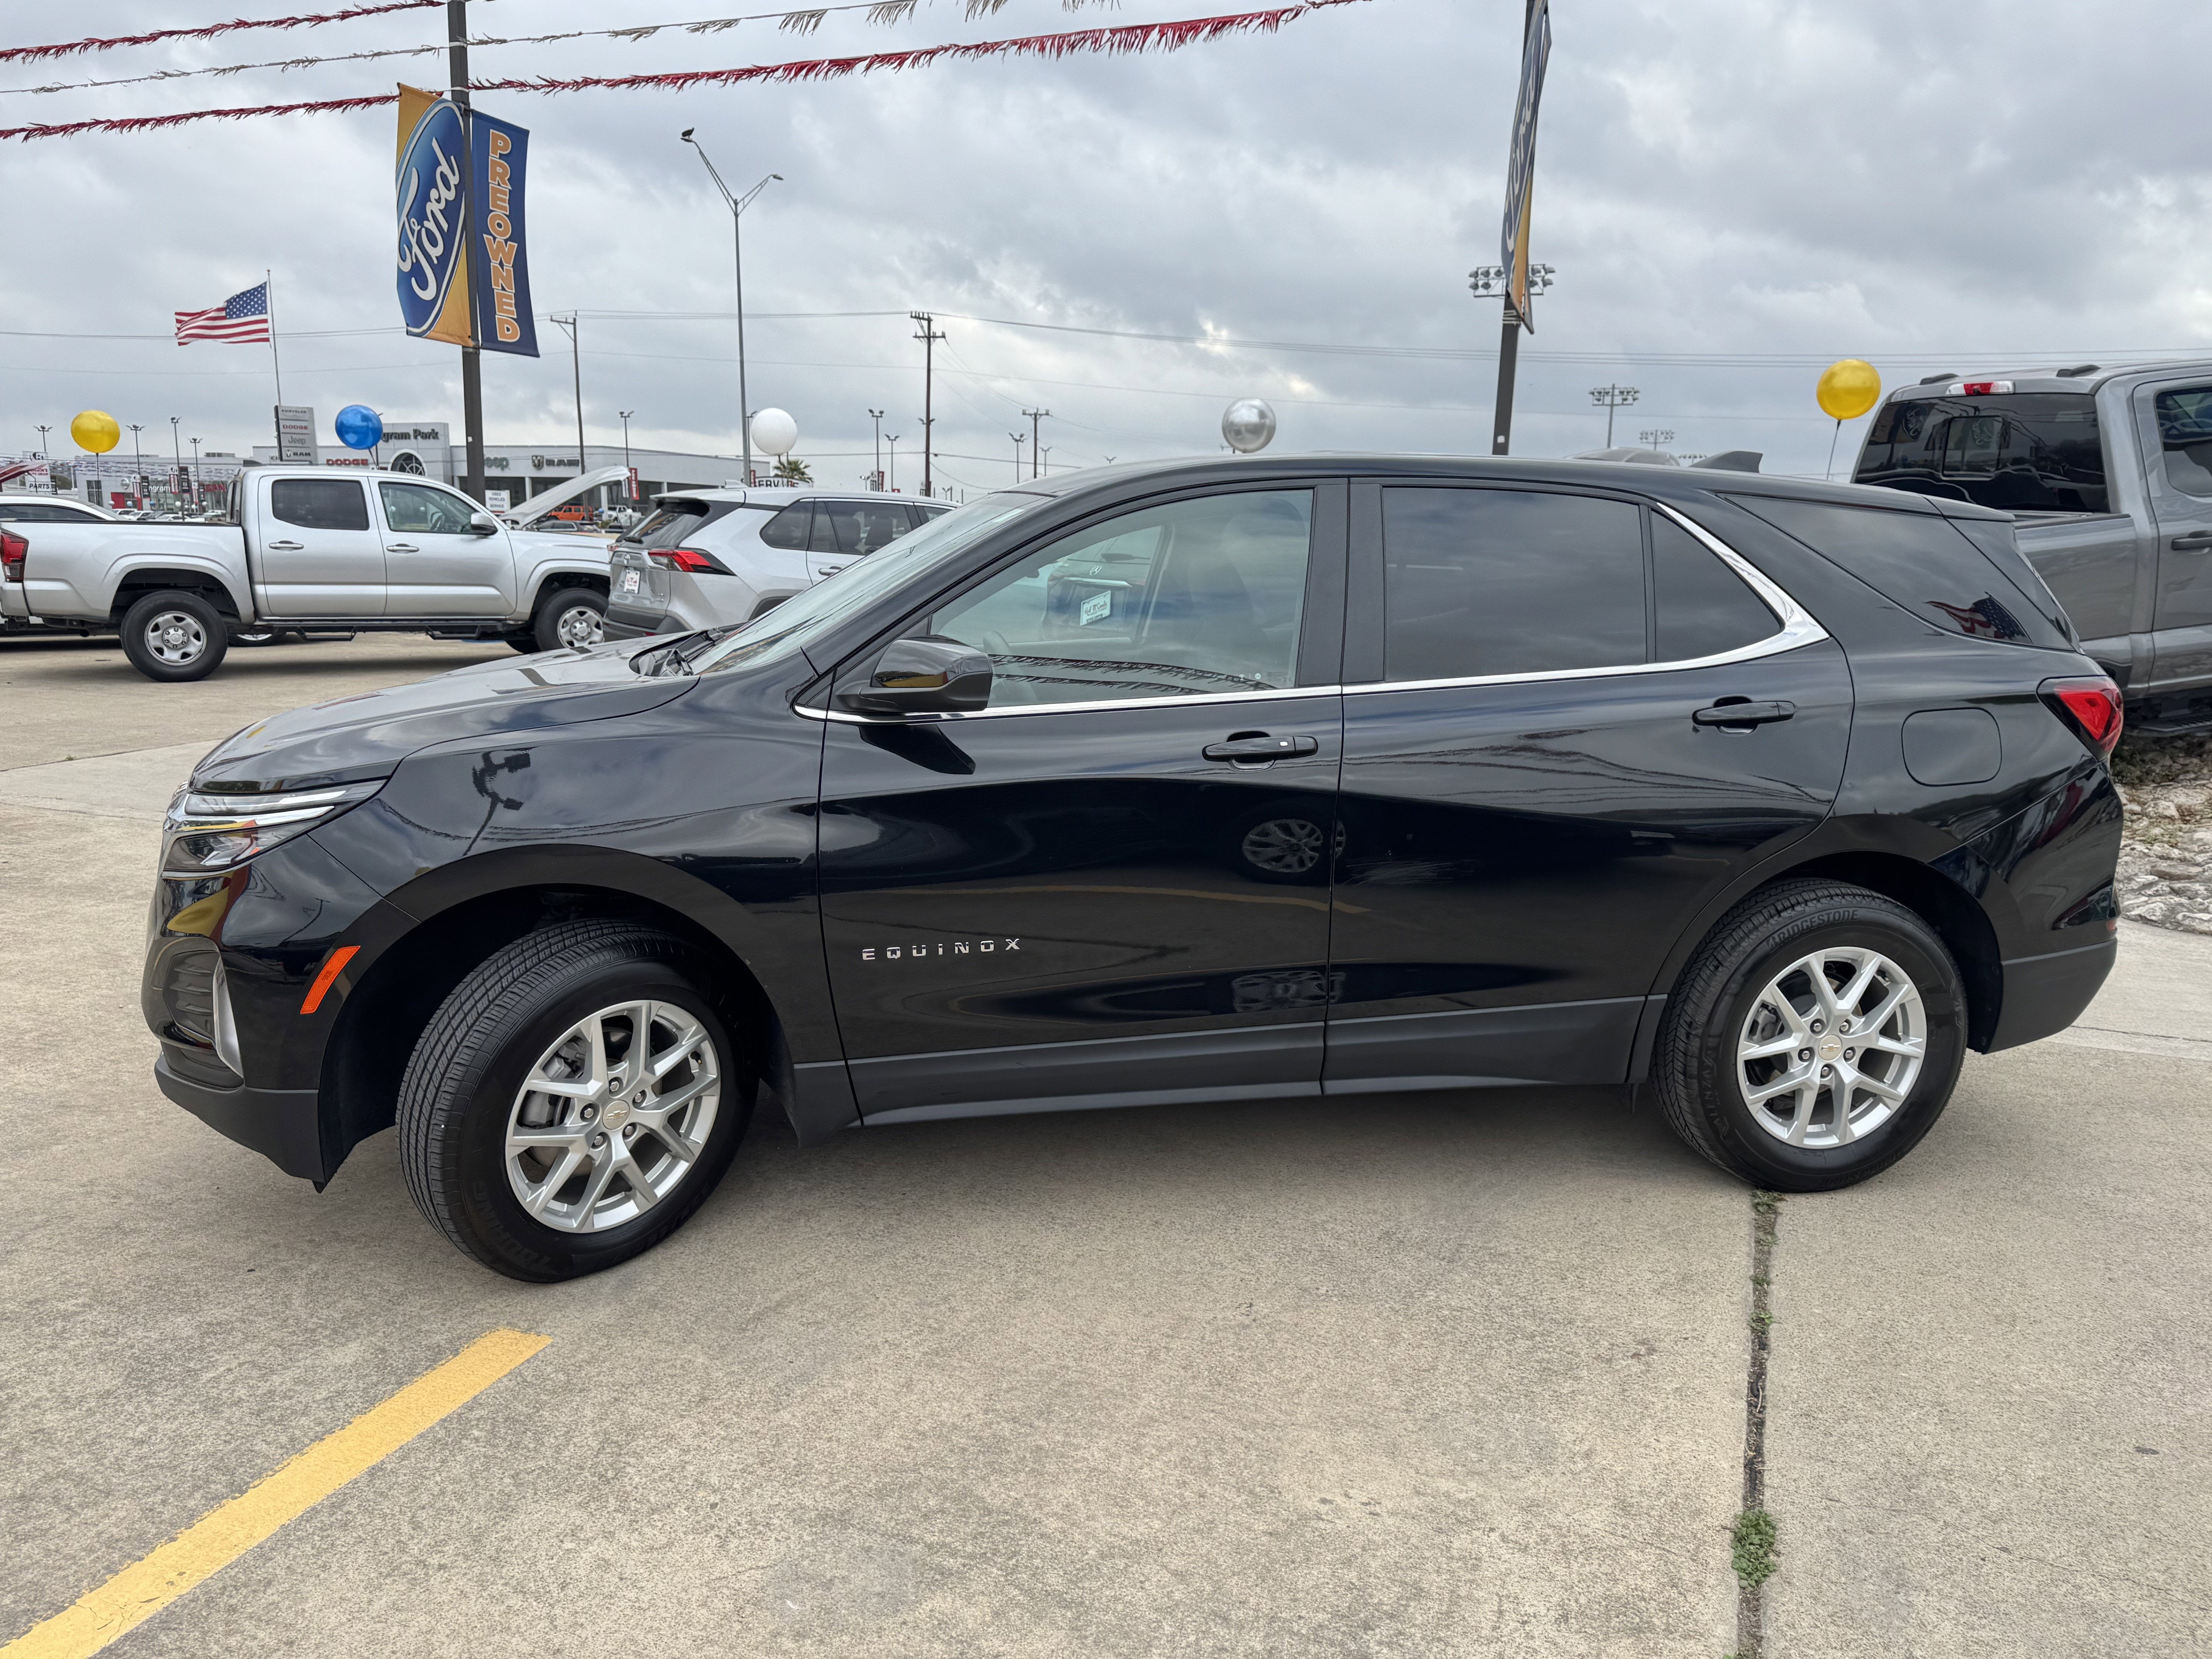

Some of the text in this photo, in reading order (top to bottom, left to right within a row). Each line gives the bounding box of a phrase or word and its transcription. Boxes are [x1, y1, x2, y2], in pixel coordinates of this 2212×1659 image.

[398, 137, 460, 301] Ford
[483, 129, 520, 343] PREOWNED
[288, 436, 306, 445] Jeep
[381, 428, 439, 443] gram Park
[484, 457, 510, 471] eep
[1765, 910, 1858, 948] BRIDGESTONE
[862, 938, 1020, 960] EQUINOX
